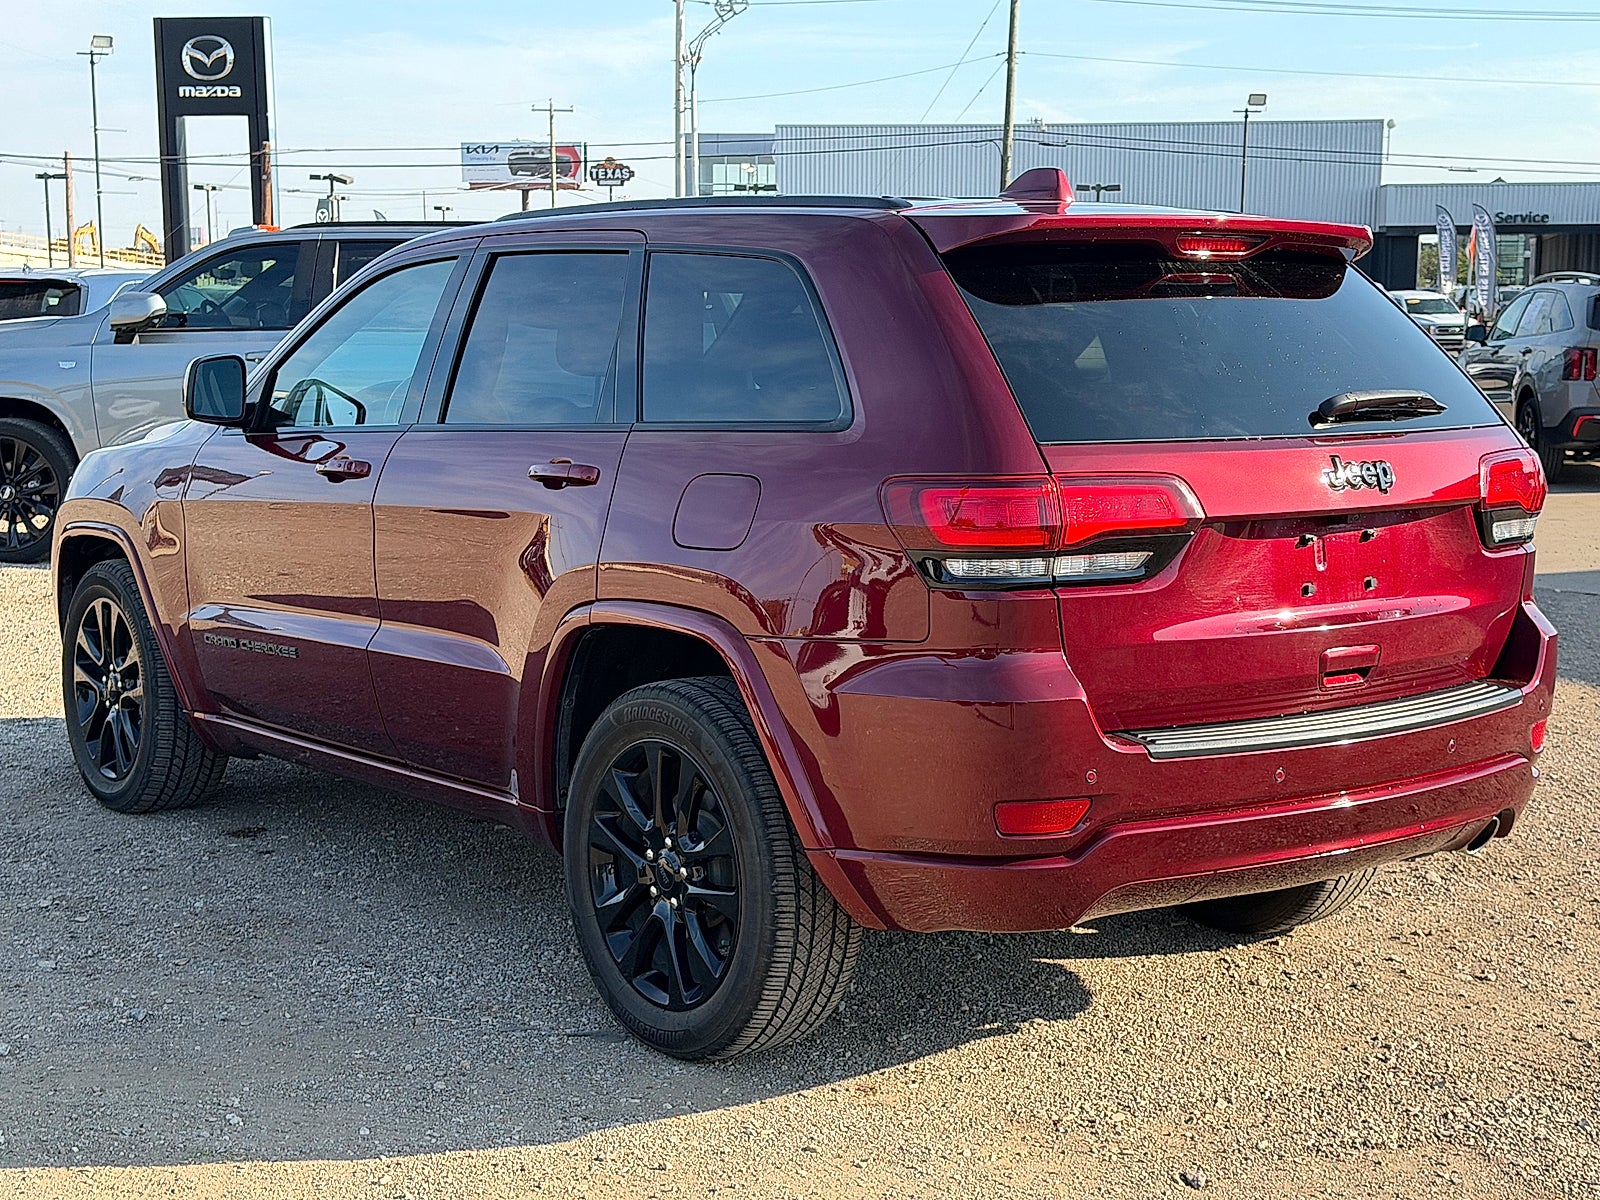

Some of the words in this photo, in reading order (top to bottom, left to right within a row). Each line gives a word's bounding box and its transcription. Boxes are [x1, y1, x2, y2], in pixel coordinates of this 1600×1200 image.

[178, 86, 242, 98] mazda
[466, 144, 500, 155] KIA
[591, 168, 630, 179] TEXAS
[1495, 211, 1550, 224] Service
[1326, 455, 1394, 495] Jeep
[204, 633, 239, 649] GRAND
[240, 639, 299, 659] CHEROKEE
[623, 706, 695, 738] BRIDGESTONE
